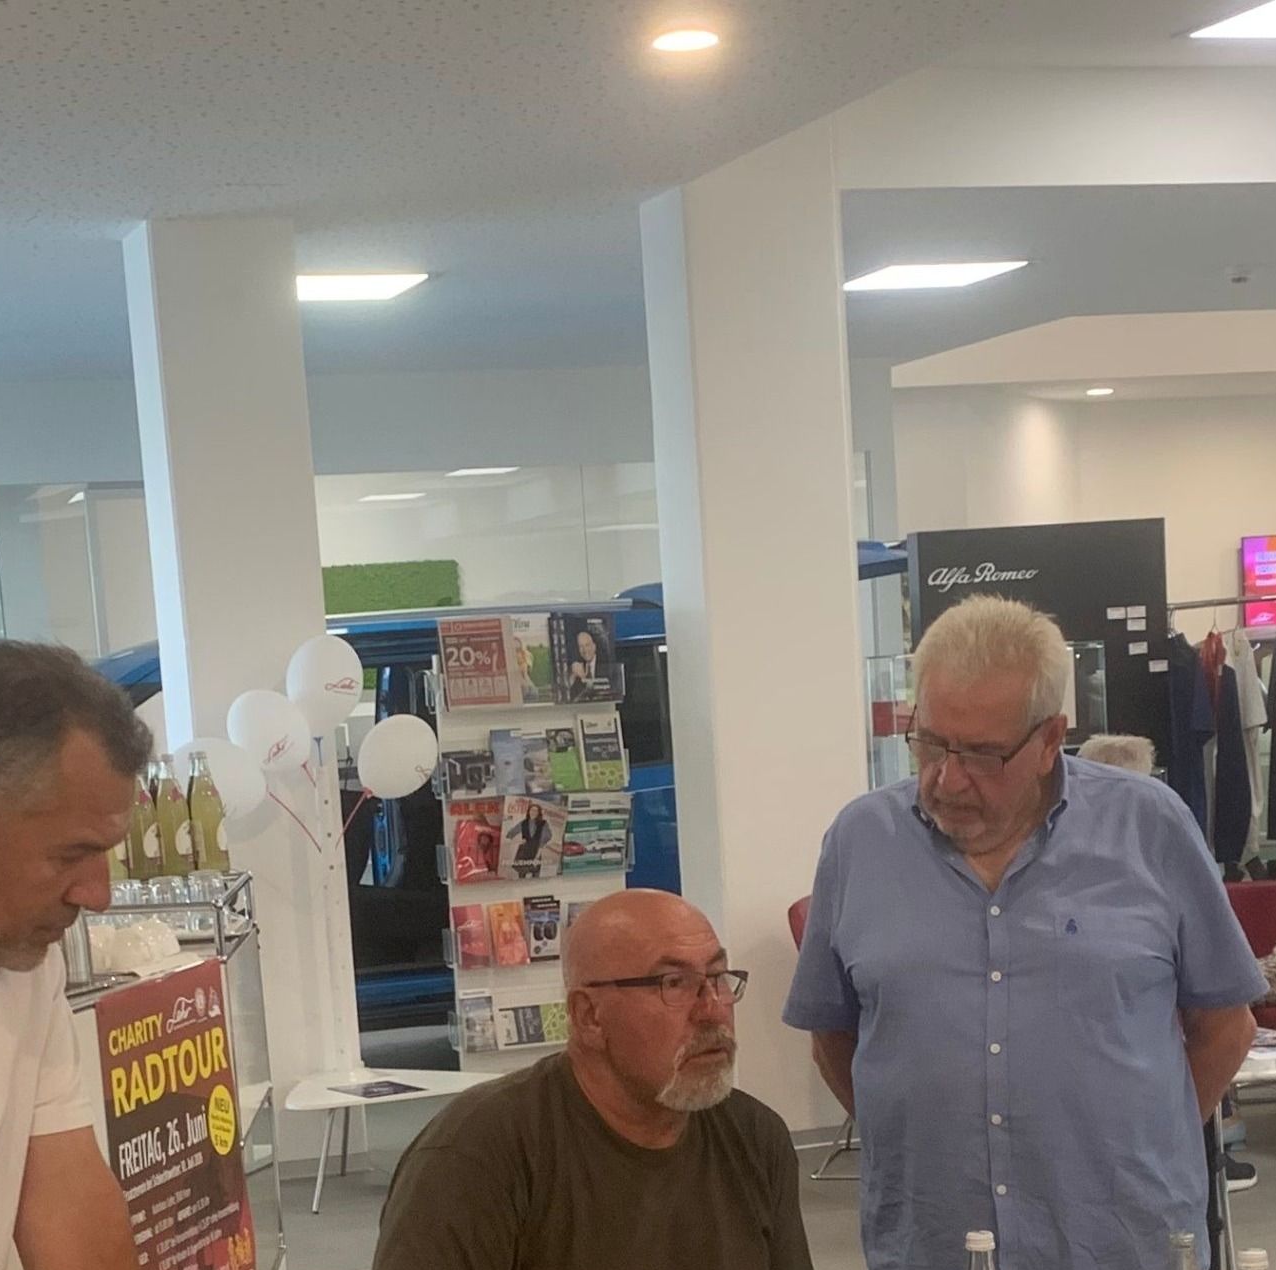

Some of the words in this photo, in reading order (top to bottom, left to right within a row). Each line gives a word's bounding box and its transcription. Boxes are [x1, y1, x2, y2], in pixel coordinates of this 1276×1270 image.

[928, 567, 973, 593] Alfa
[974, 562, 1039, 583] Romeo
[446, 645, 492, 668] 20%
[108, 1013, 163, 1056] CHARITY
[111, 1027, 228, 1118] RADTOUR
[119, 1126, 166, 1180] FREITAG,
[166, 1118, 185, 1156] 26.
[186, 1104, 208, 1148] Juni
